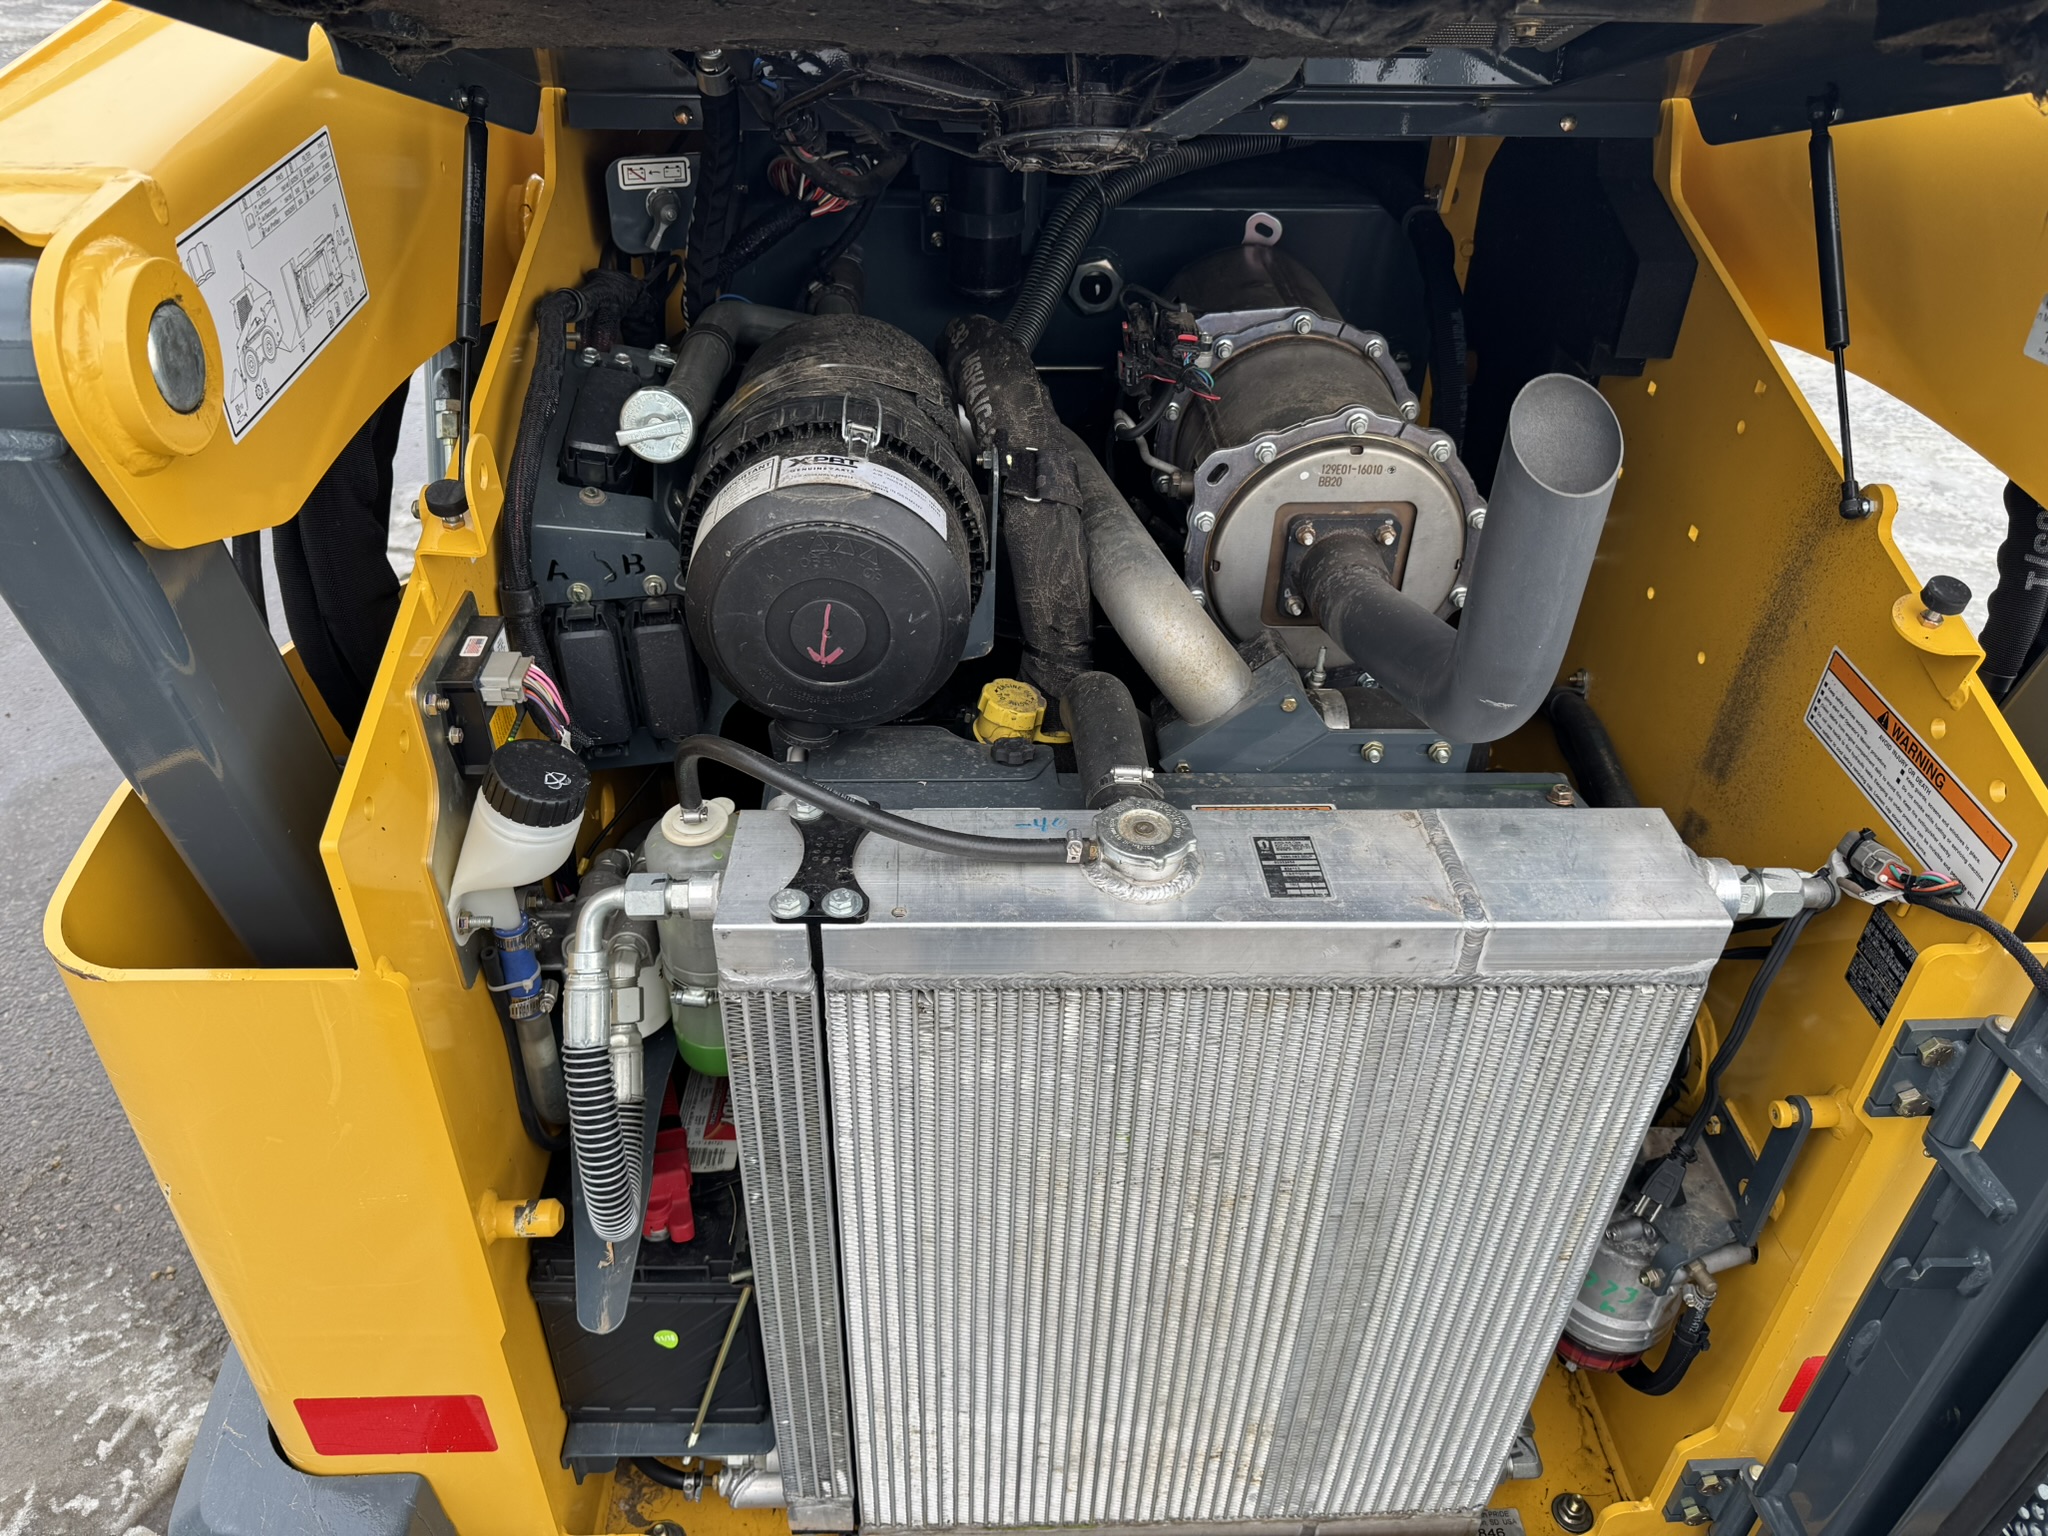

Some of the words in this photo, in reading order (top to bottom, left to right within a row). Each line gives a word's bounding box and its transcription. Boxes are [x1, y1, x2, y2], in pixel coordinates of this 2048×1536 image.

[1321, 464, 1383, 475] 129E01-16010
[1318, 476, 1342, 487] BB20
[622, 553, 646, 575] B
[1889, 722, 1947, 791] WARNING
